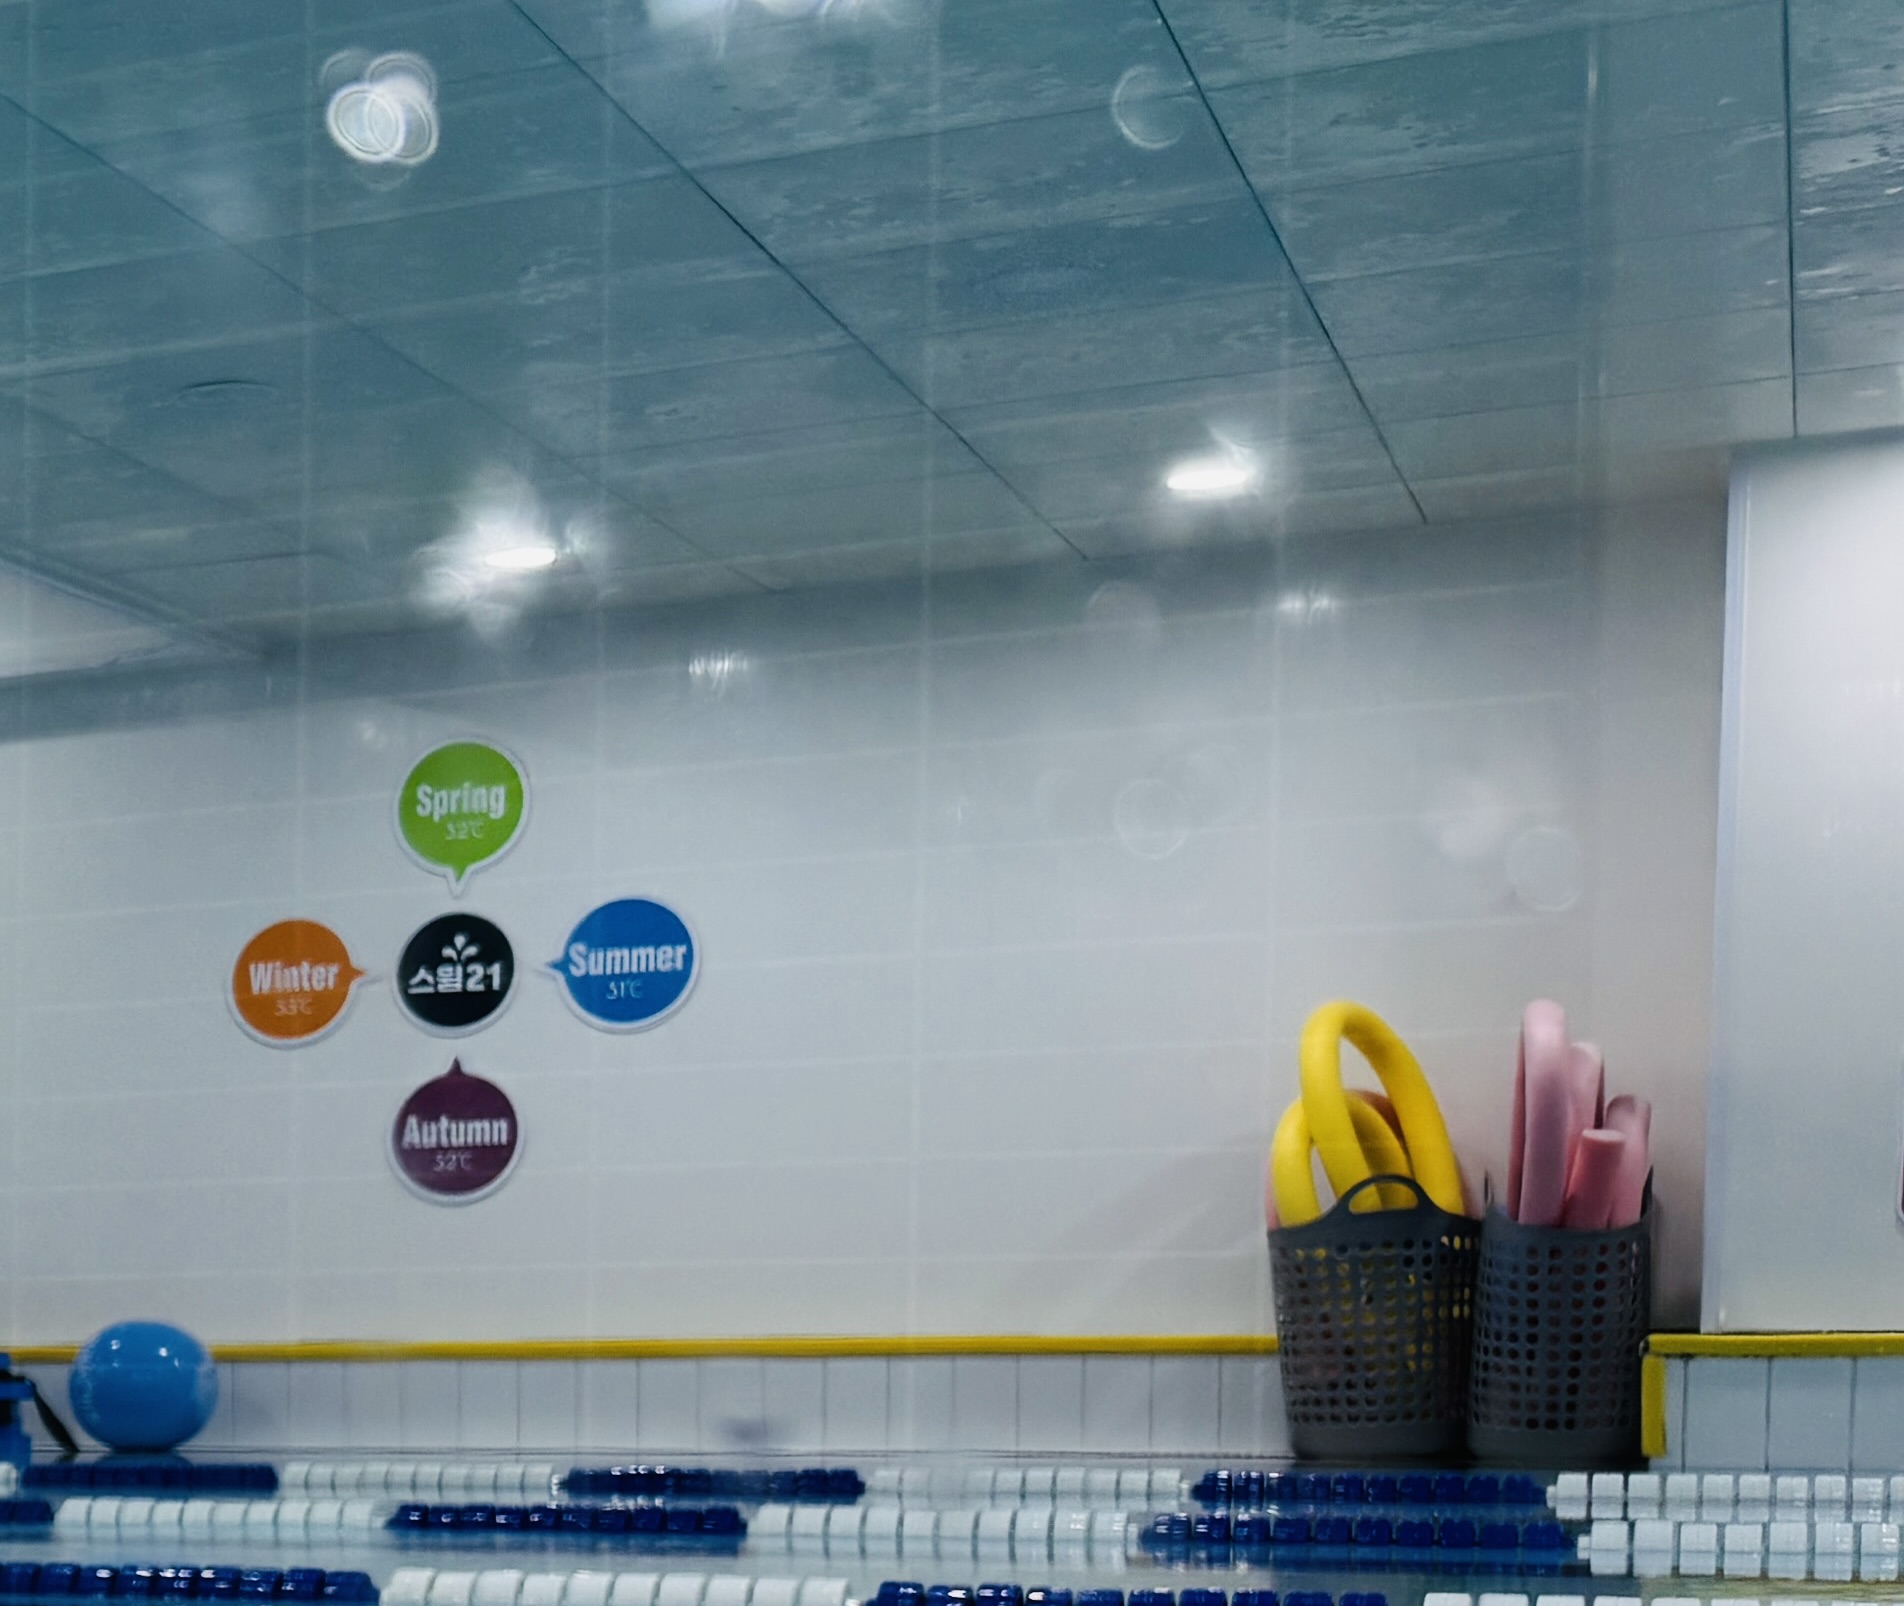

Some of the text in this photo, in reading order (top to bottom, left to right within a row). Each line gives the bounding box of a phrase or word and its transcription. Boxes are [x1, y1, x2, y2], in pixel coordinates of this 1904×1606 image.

[416, 781, 506, 822] Spring
[569, 942, 687, 977] Summer
[249, 961, 340, 995] Winter
[407, 961, 501, 994] 스윔21
[402, 1114, 508, 1149] Autumn
